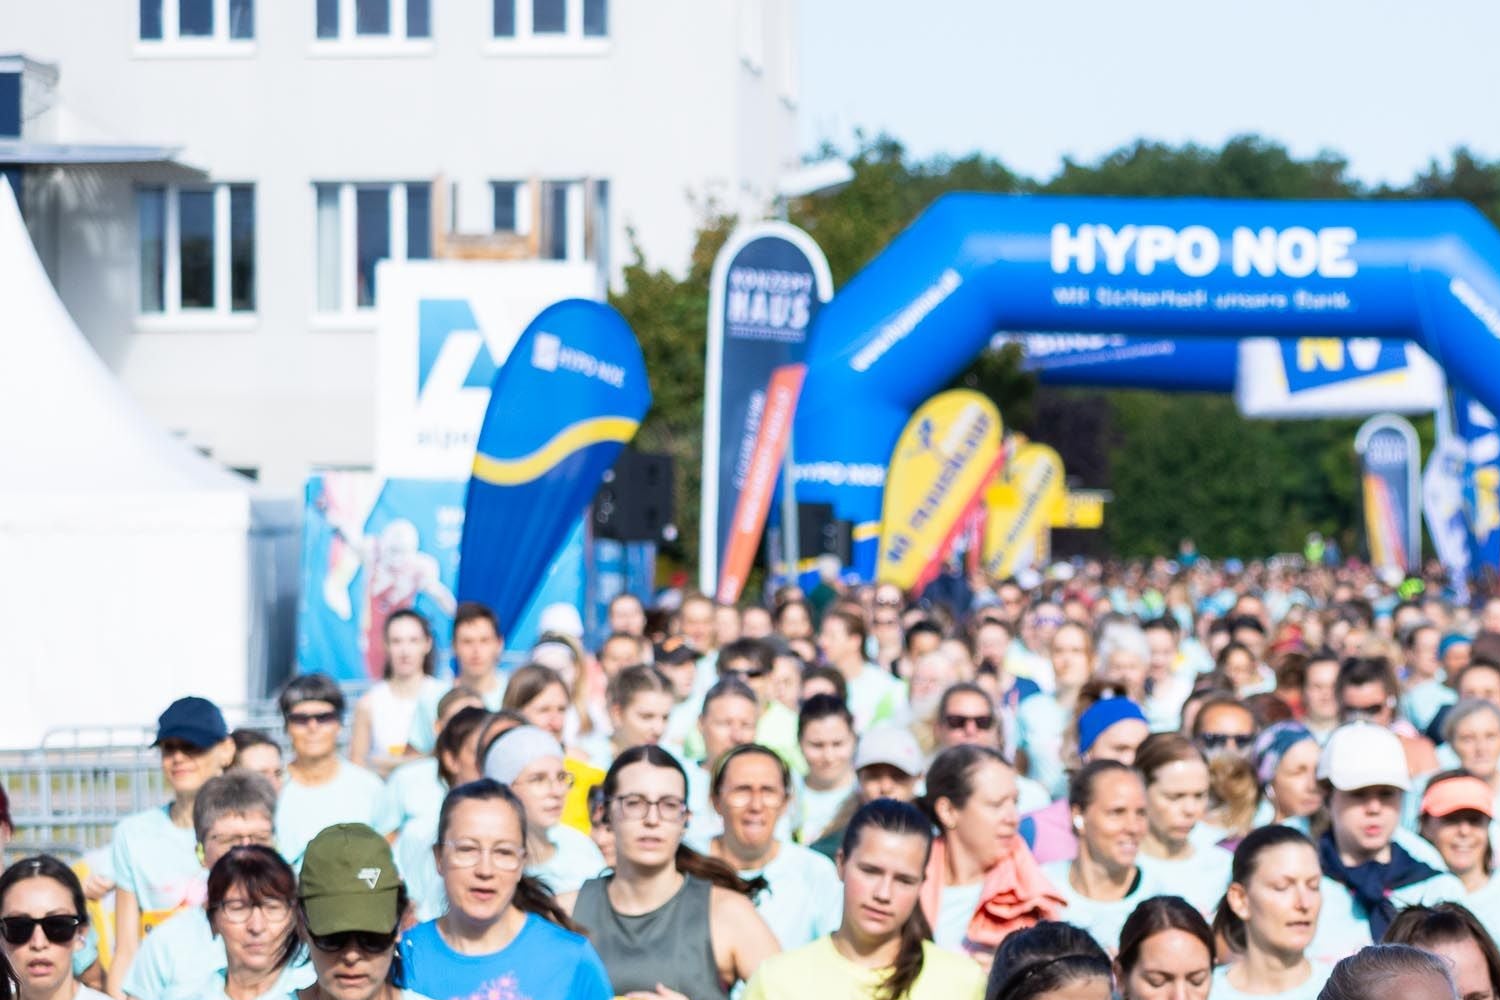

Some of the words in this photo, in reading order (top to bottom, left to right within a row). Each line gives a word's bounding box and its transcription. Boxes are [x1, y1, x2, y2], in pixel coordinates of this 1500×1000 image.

[1050, 223, 1220, 277] HYPO
[1232, 226, 1358, 278] NOE
[728, 290, 811, 330] HAUS
